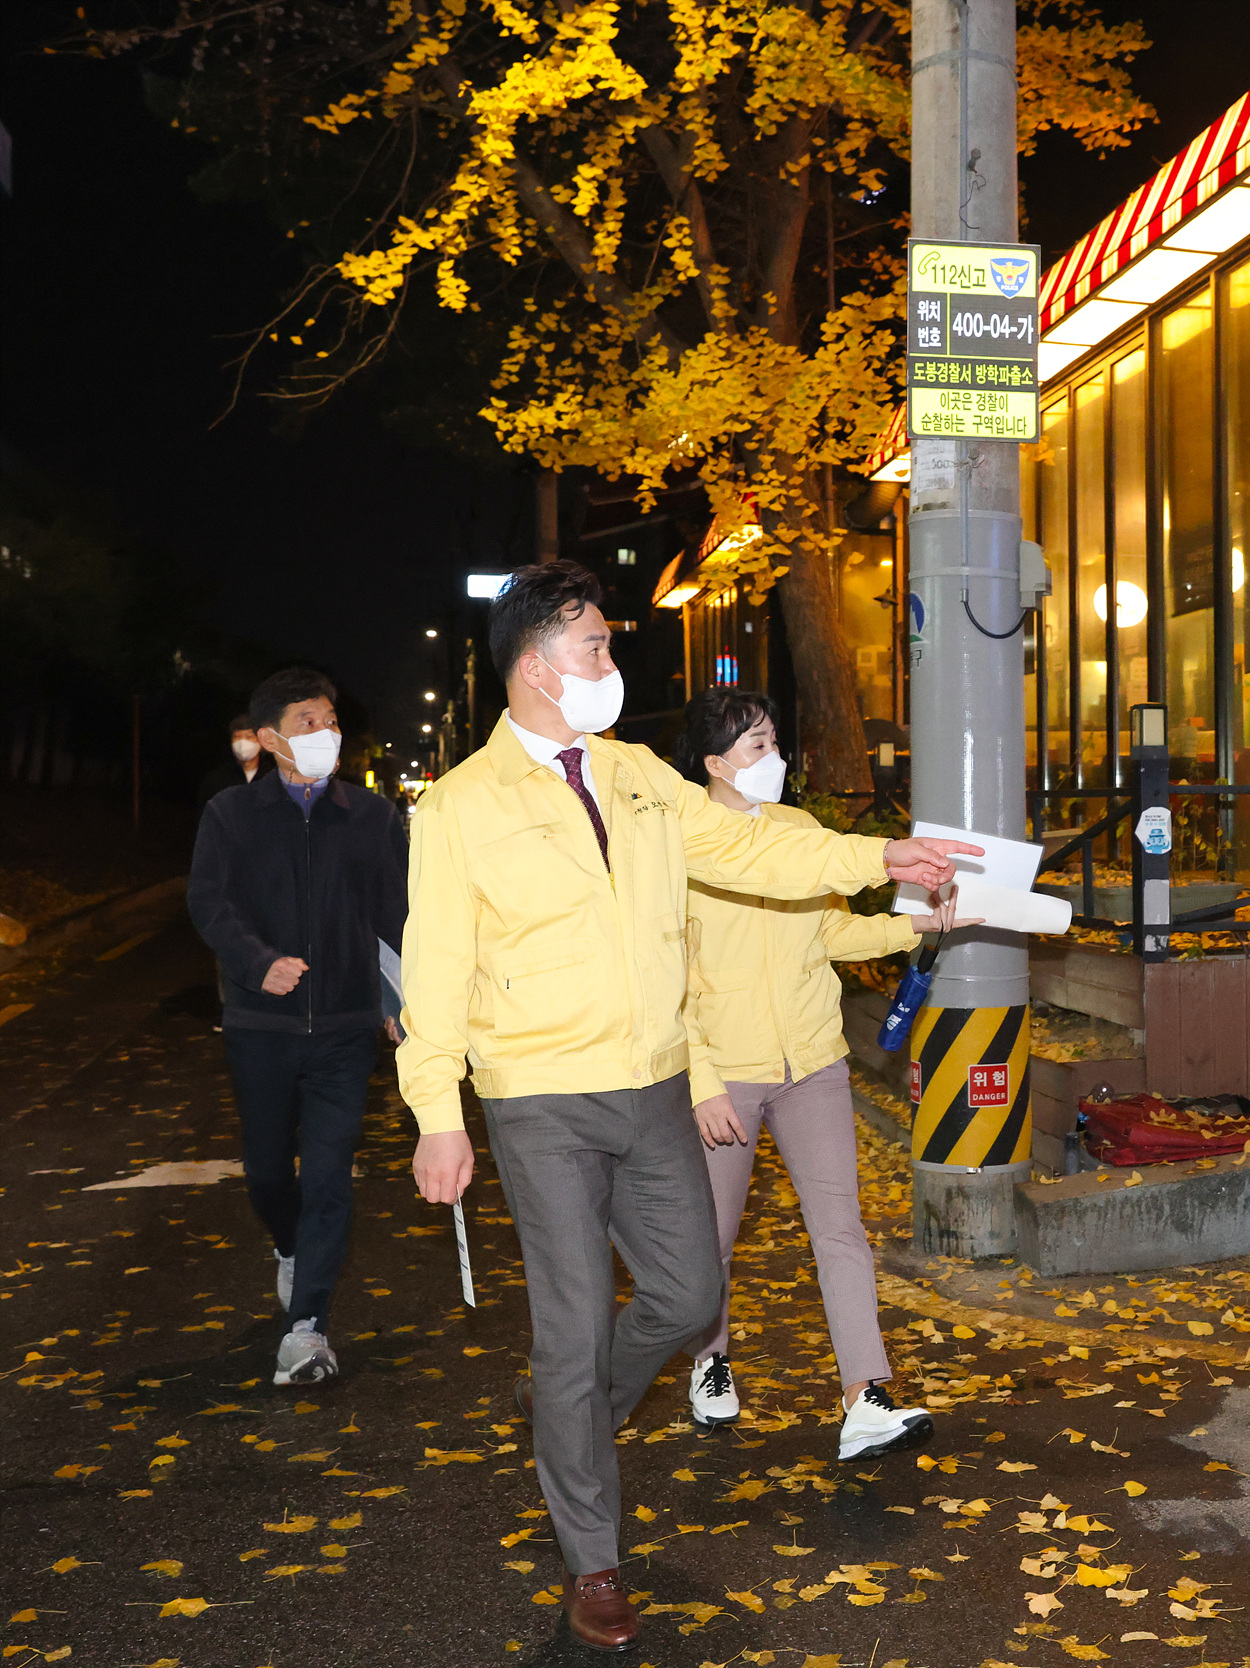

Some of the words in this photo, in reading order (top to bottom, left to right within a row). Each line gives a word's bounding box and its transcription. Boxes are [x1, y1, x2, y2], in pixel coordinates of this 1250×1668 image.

[931, 264, 987, 289] 112신고
[917, 300, 941, 322] 위치
[917, 327, 942, 348] 번호
[952, 312, 1034, 344] 400-04-가
[913, 361, 972, 384] 도봉경찰서
[975, 364, 1034, 386] 방학파출소
[940, 391, 973, 411] 이곳은
[976, 392, 1009, 413] 경찰이
[921, 412, 965, 432] 순찰하는
[972, 415, 1027, 435] 구역입니다
[972, 1092, 1006, 1101] DANGER
